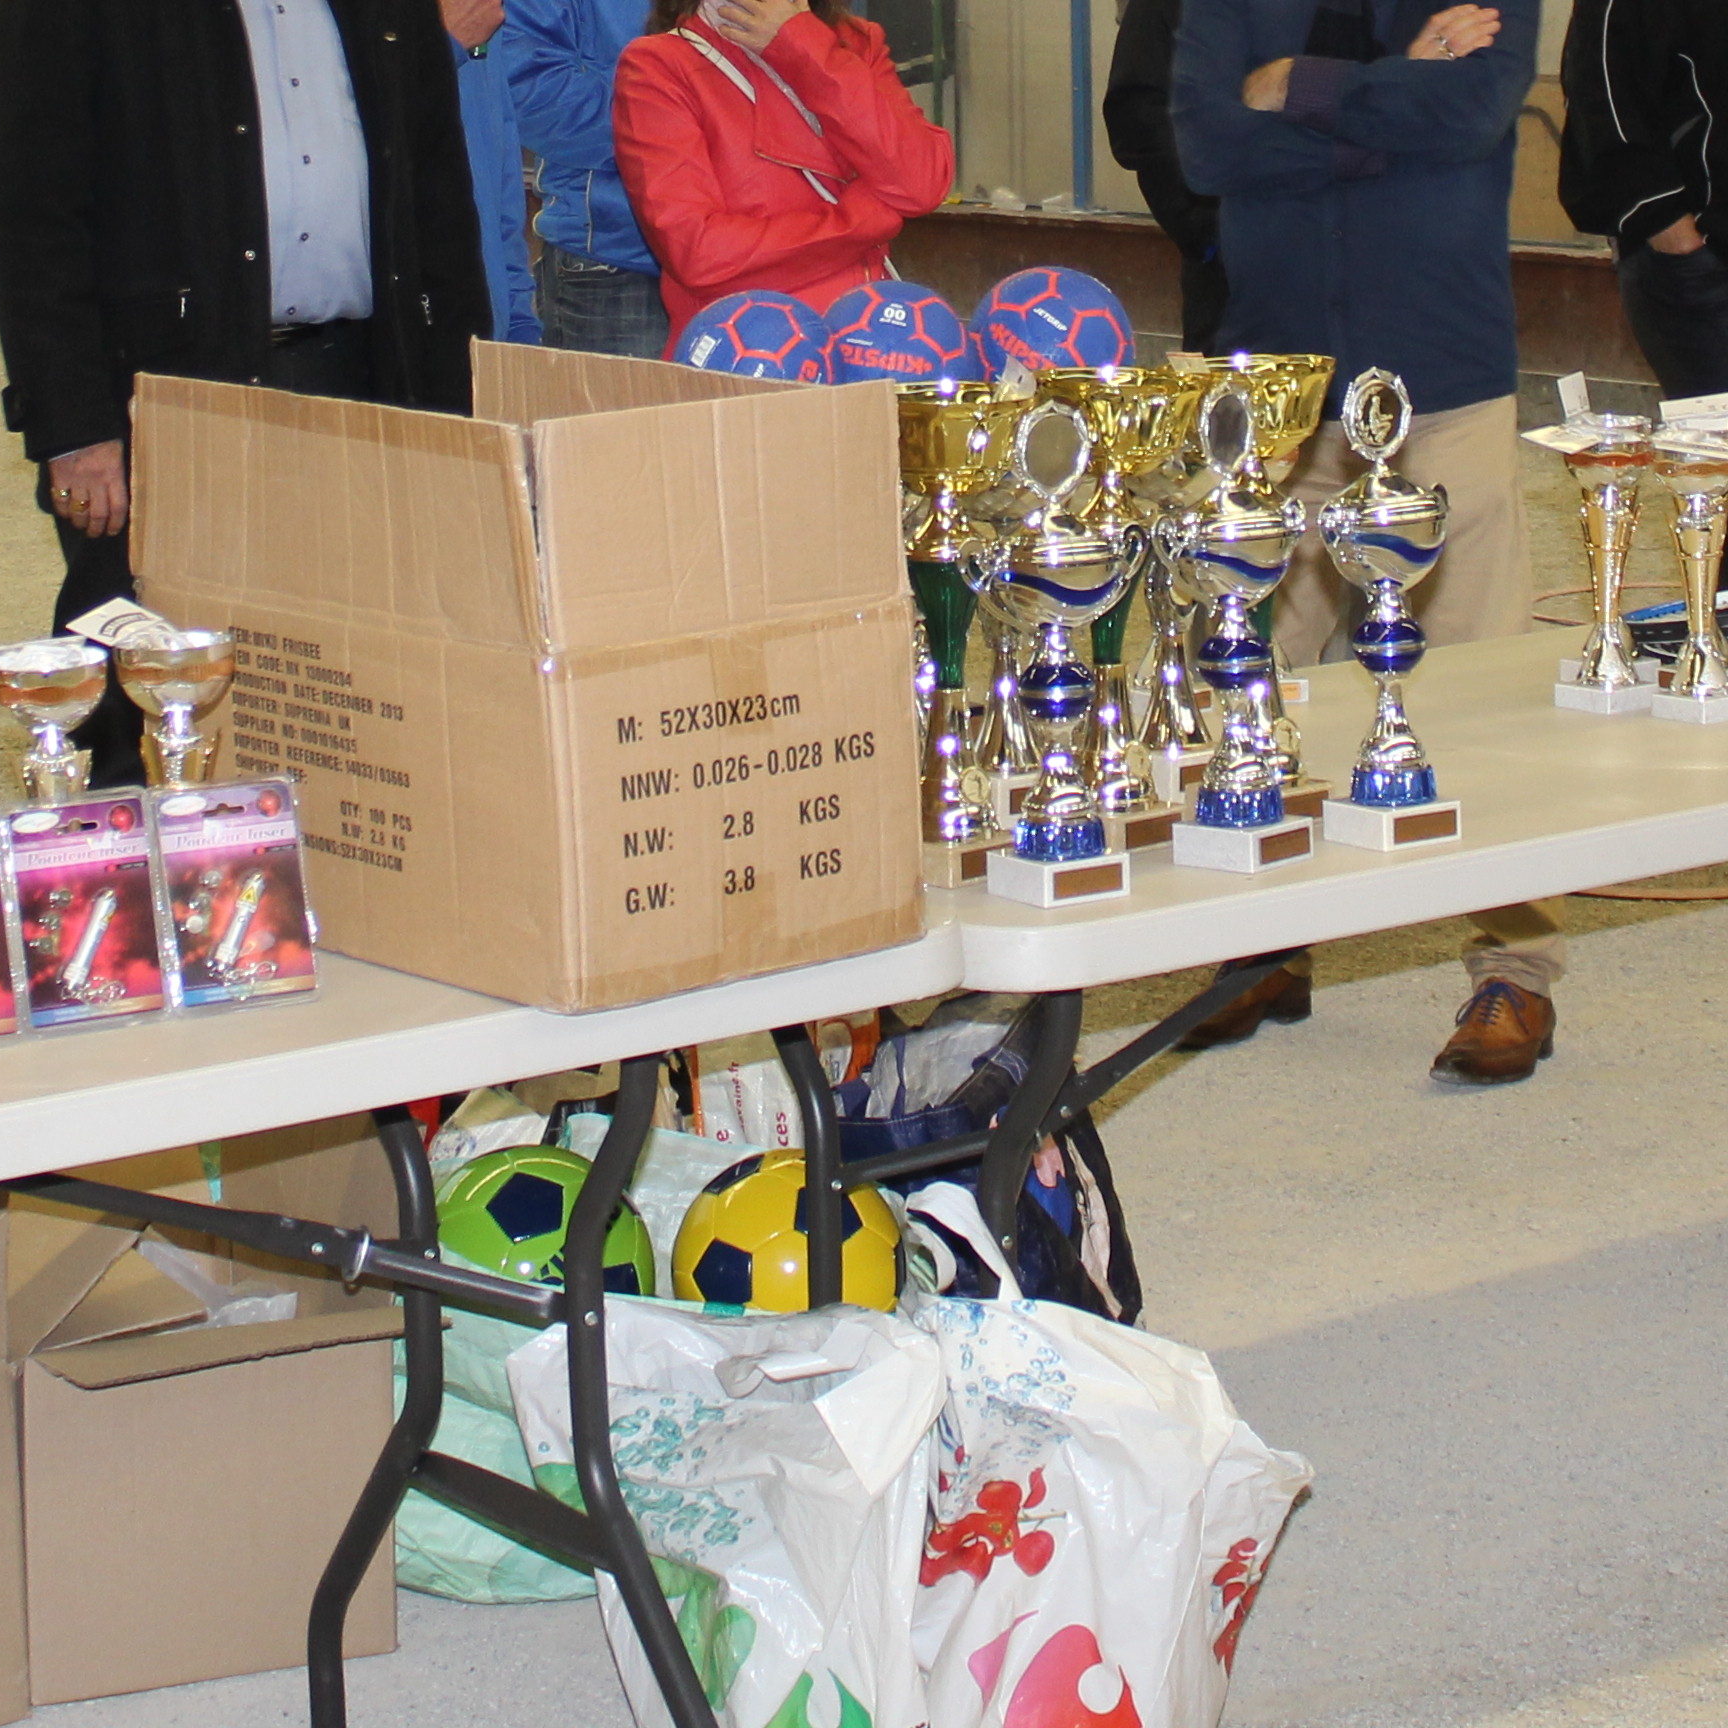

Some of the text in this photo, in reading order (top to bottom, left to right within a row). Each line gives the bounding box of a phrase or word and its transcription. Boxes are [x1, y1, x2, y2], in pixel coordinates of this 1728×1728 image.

[616, 715, 644, 745] M:
[621, 768, 681, 802] NNW:
[834, 730, 876, 764] KGS
[623, 793, 842, 859] N.W: 2.8 KGS
[625, 847, 843, 915] G.W: 3.8 KGS
